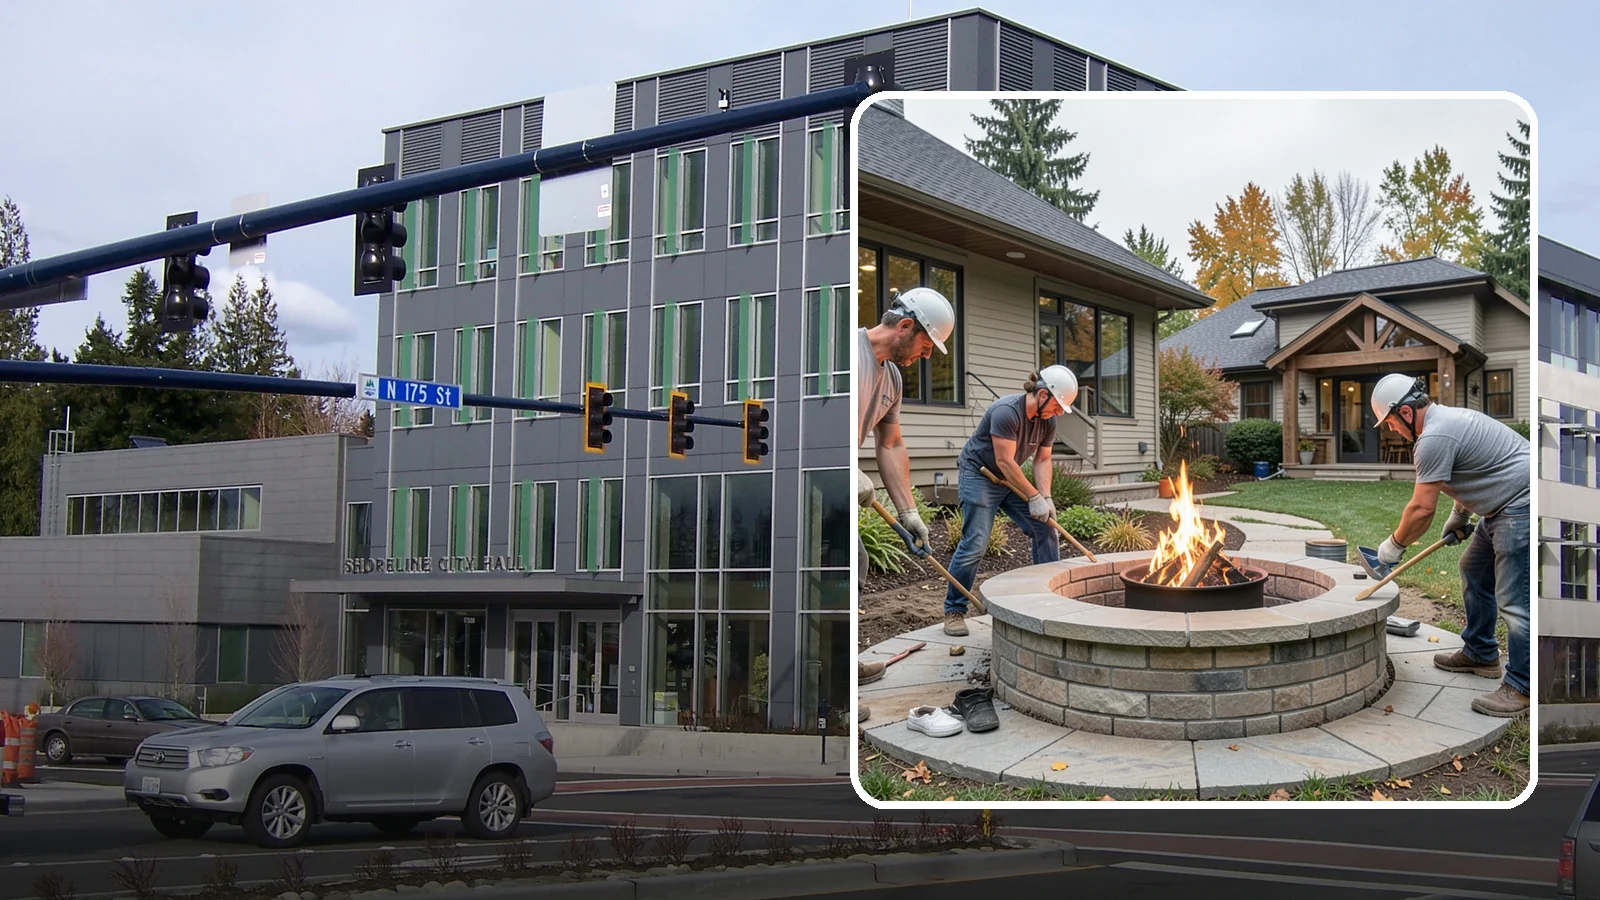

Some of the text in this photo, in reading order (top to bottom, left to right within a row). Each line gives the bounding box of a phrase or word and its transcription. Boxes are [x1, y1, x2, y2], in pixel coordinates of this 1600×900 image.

[387, 380, 451, 406] N 175 St
[344, 555, 526, 574] SHORELINE CITY HALL
